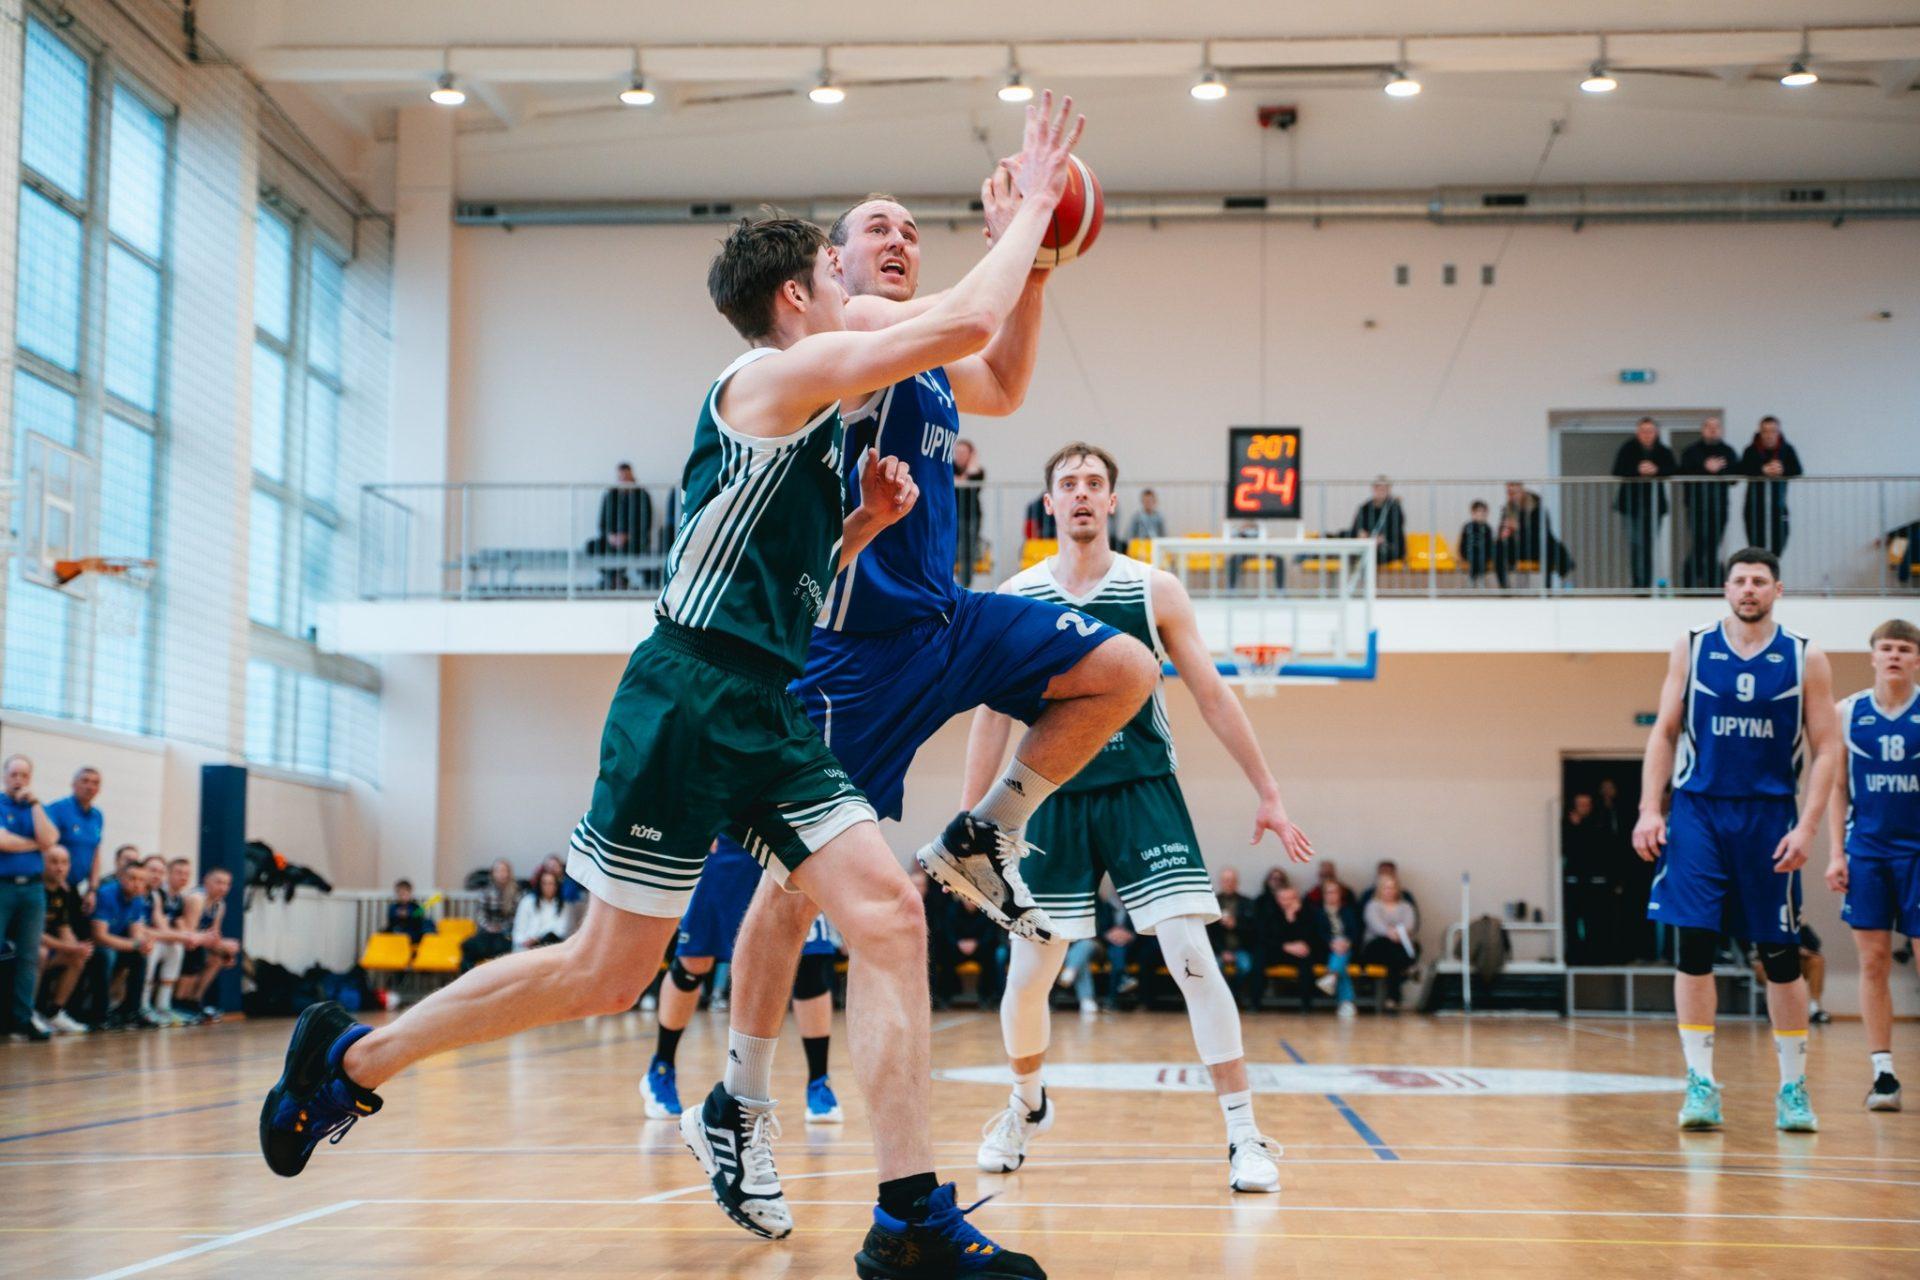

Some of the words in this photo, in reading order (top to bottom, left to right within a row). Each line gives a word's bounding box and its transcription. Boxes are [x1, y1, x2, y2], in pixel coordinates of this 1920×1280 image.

[1234, 466, 1297, 512] 24
[1056, 608, 1103, 637] 2
[1736, 673, 1755, 702] 9
[1711, 715, 1774, 738] UPYNA
[1878, 734, 1905, 761] 18
[1865, 774, 1919, 793] UPYNA
[1140, 846, 1161, 861] UAB
[1150, 856, 1187, 872] statyba
